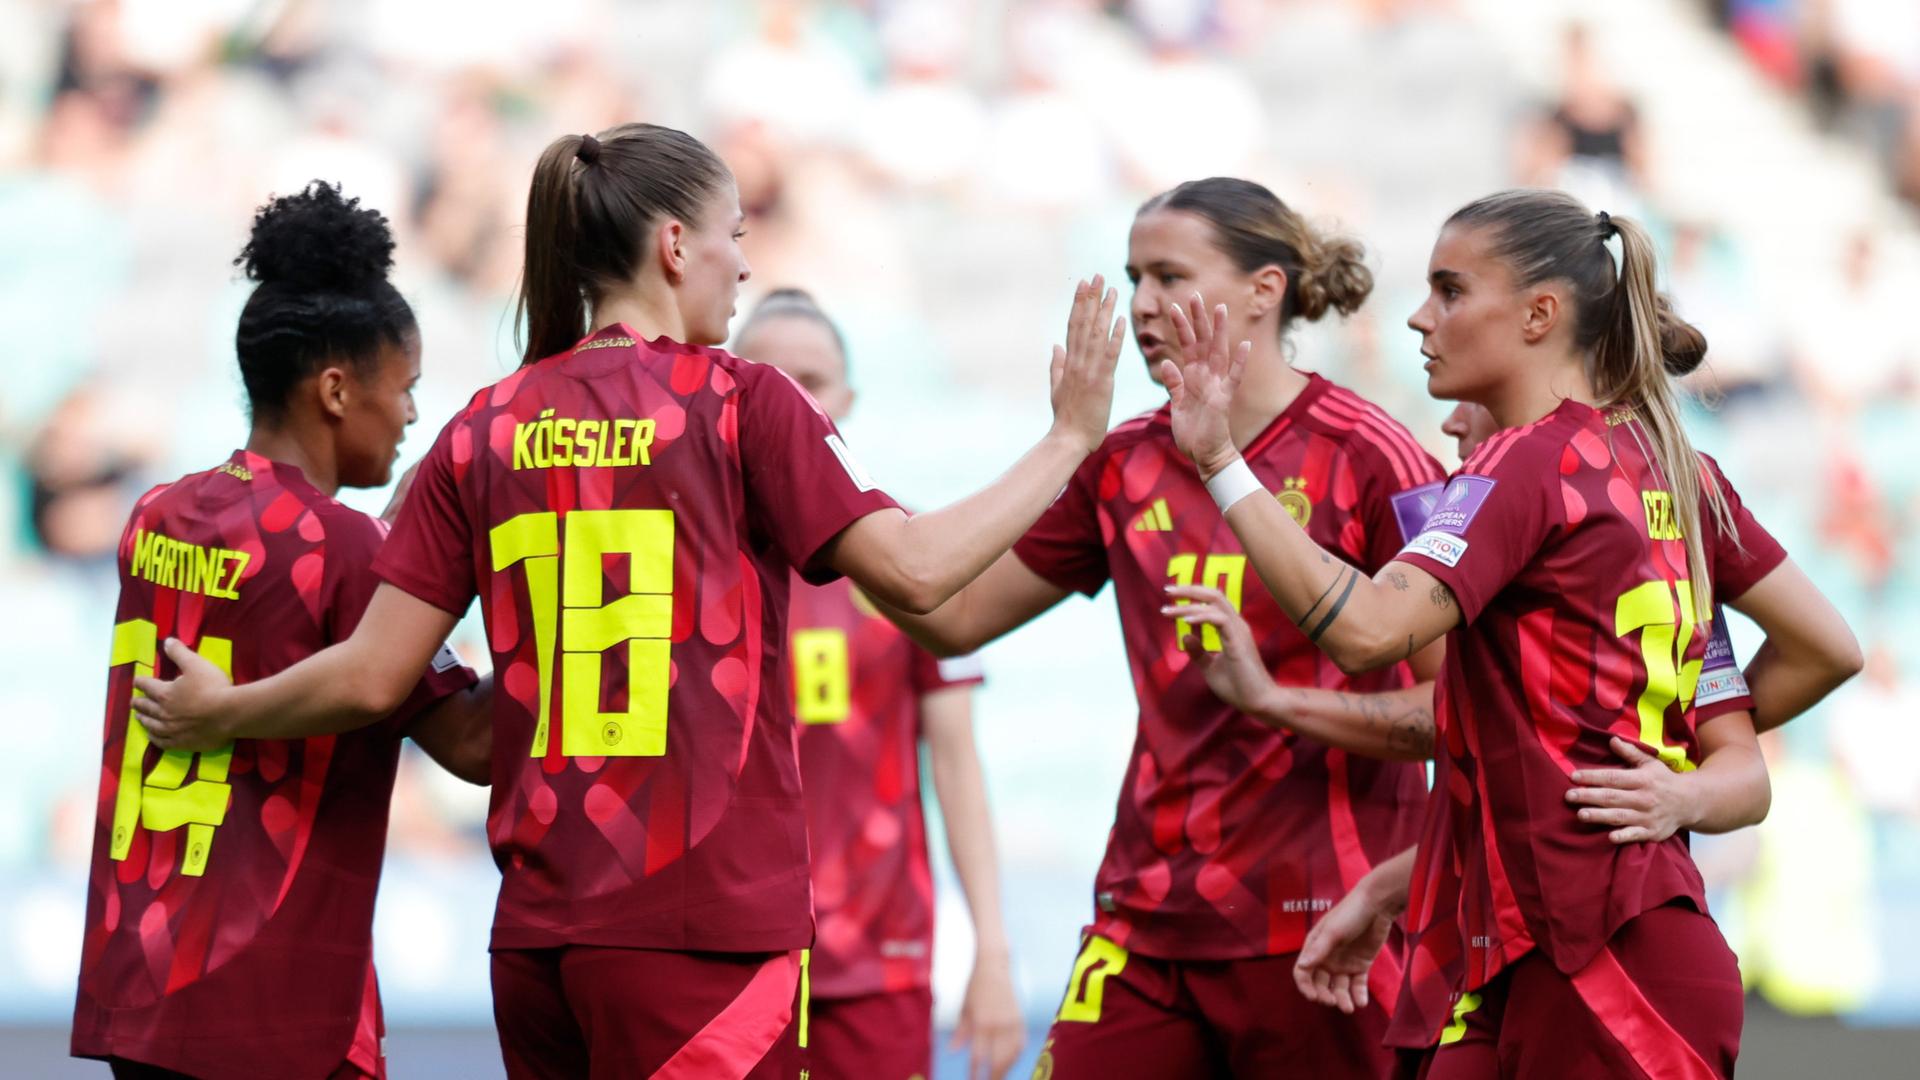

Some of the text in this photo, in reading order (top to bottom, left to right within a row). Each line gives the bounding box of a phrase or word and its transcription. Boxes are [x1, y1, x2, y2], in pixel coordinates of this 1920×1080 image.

[513, 408, 656, 470] KÖSSLER
[131, 528, 250, 600] MARTINEZ
[1167, 554, 1247, 652] 10
[489, 508, 675, 758] 18
[793, 629, 847, 725] 8
[109, 618, 233, 876] 14
[1058, 935, 1129, 1022] 0
